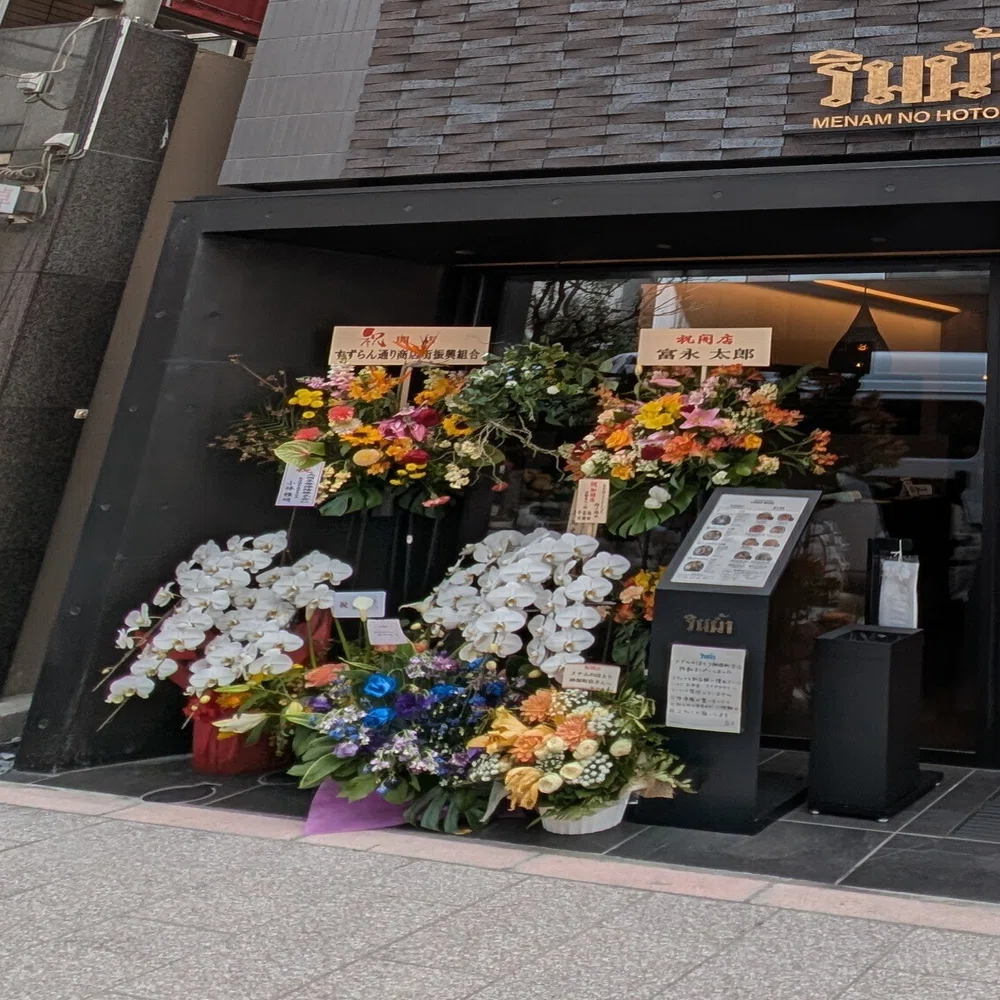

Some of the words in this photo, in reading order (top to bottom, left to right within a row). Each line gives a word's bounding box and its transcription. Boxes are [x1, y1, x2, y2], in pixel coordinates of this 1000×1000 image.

[812, 114, 892, 129] MENAM
[898, 111, 931, 124] NO
[676, 333, 734, 345] 祝開店
[657, 348, 700, 360] 富永
[709, 348, 755, 360] 太郎
